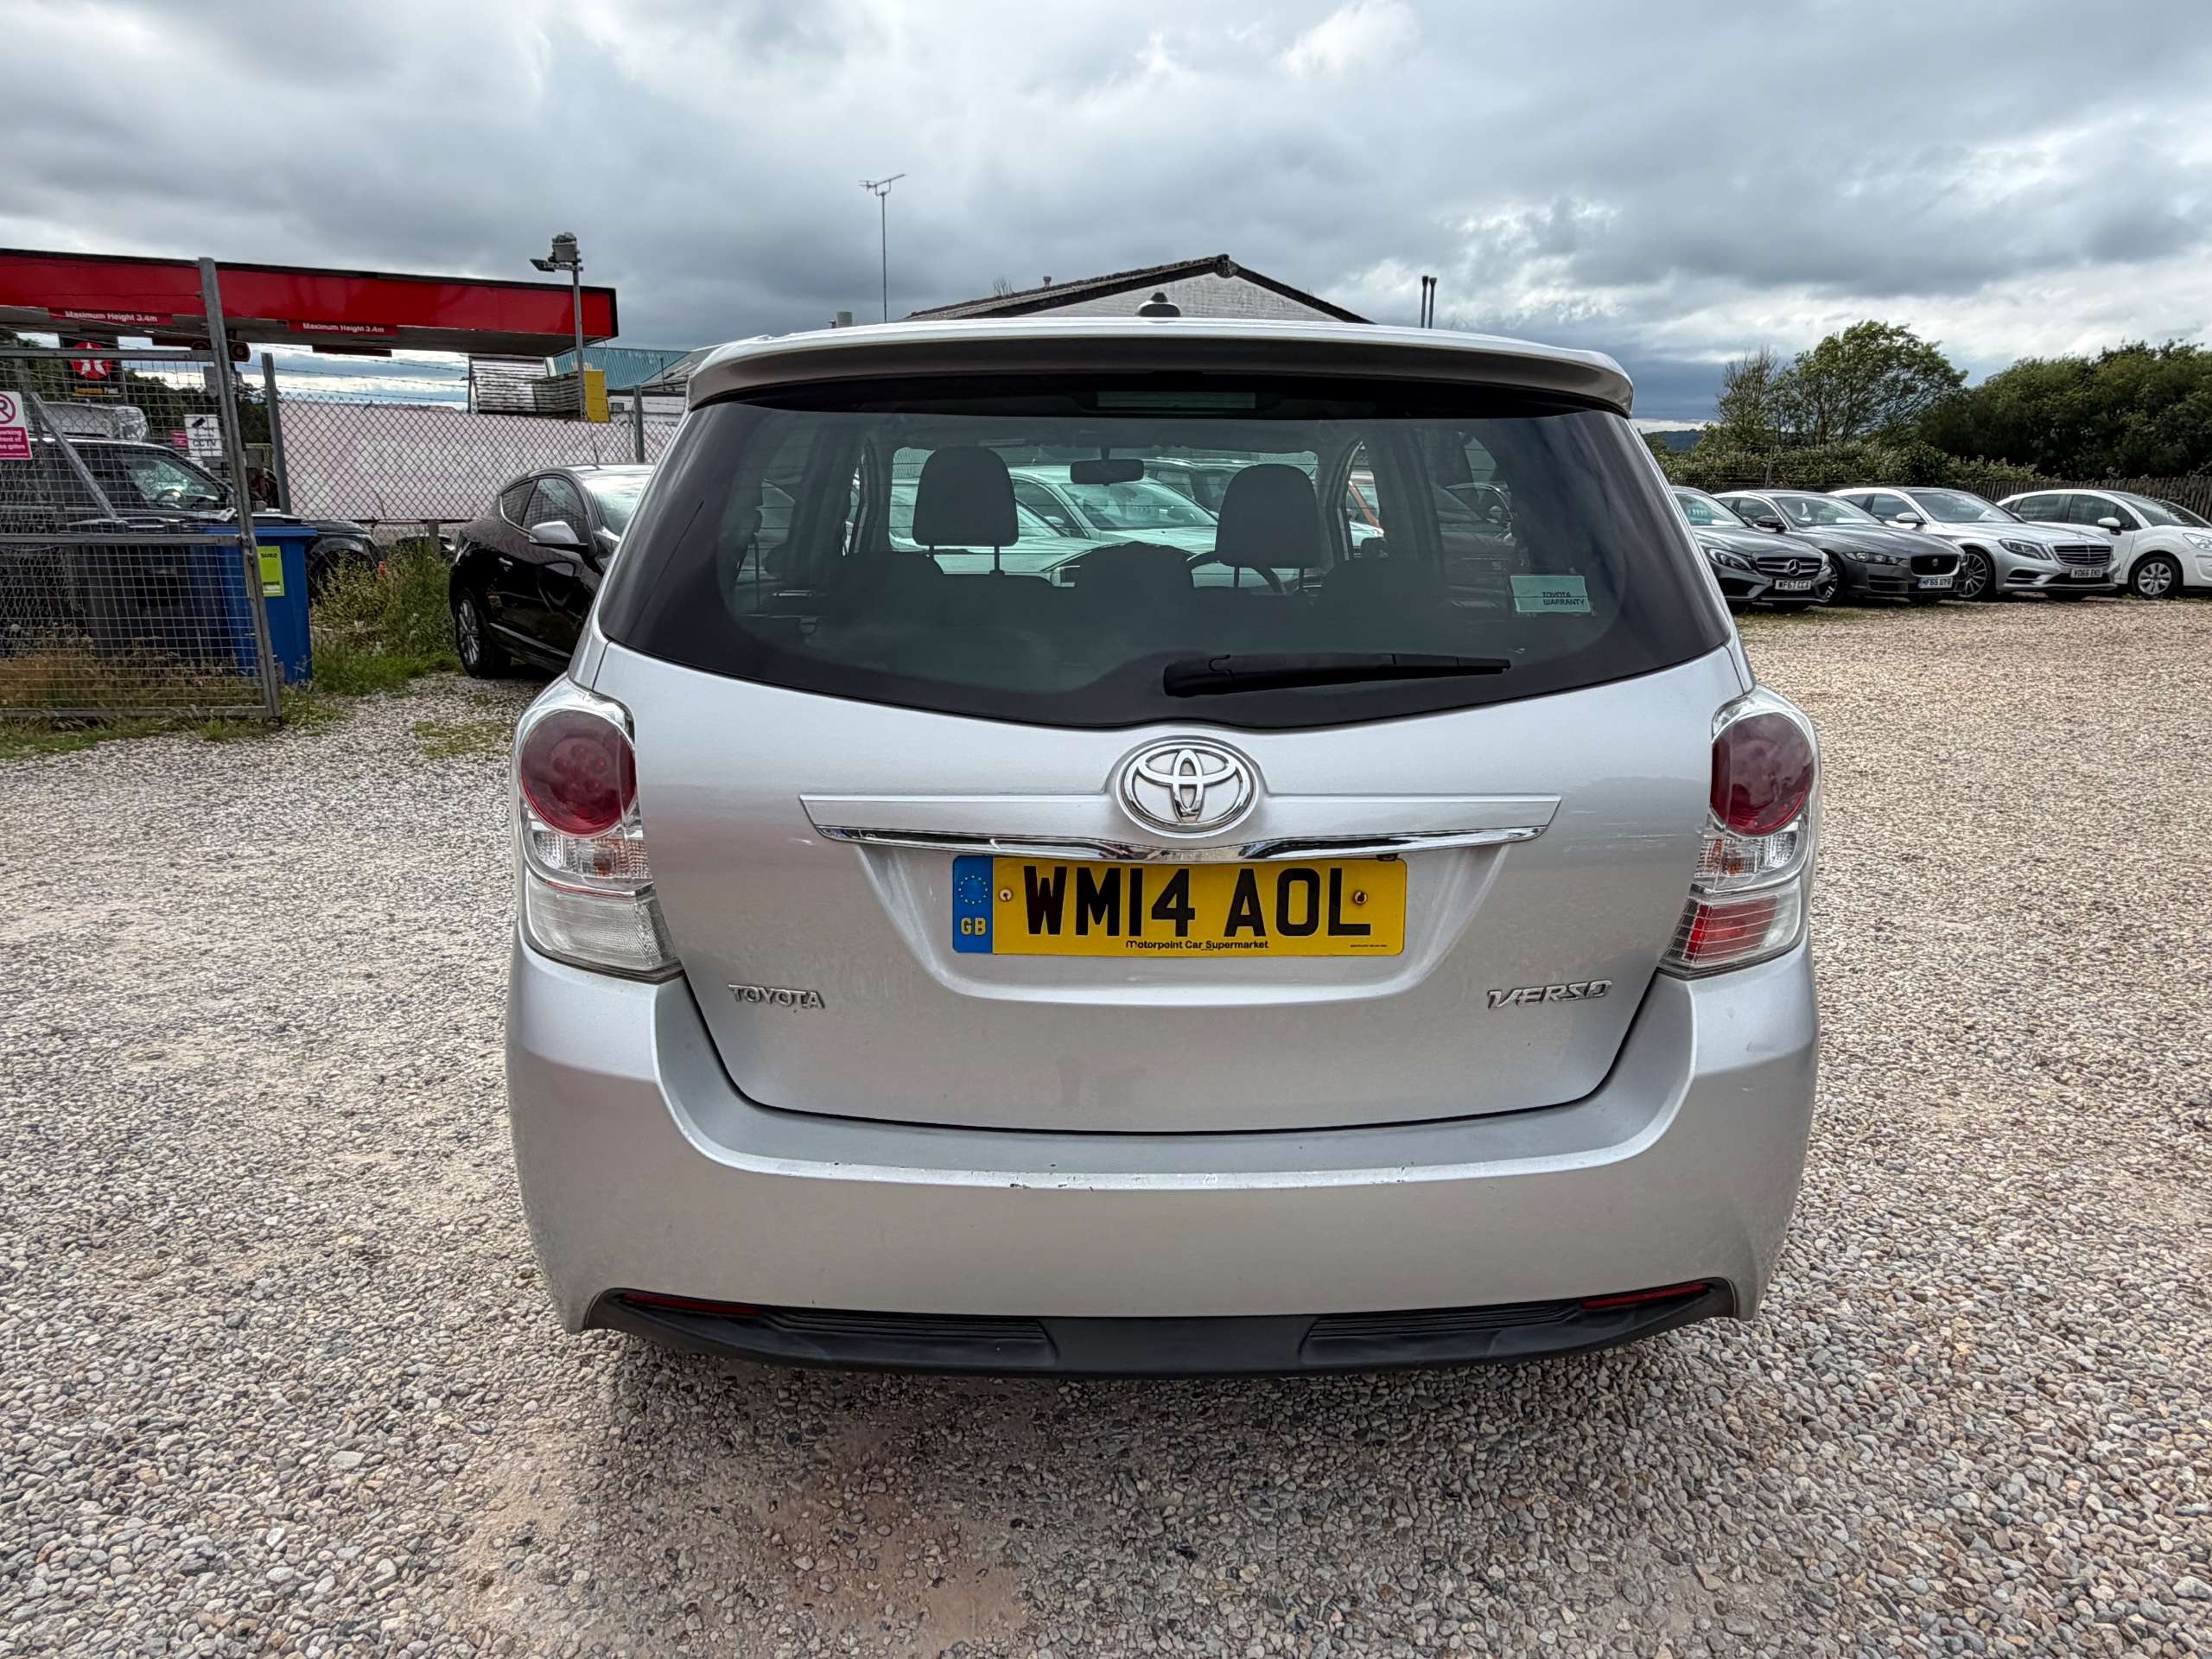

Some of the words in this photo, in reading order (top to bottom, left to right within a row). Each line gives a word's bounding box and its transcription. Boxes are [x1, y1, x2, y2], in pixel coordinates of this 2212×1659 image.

[65, 310, 105, 320] Maximum
[107, 312, 135, 322] Height
[302, 322, 339, 331] Maximum
[340, 324, 364, 334] Height
[193, 438, 216, 448] CCTV
[1023, 865, 1195, 938] WM14
[1224, 868, 1371, 938] AOL
[961, 917, 987, 936] GB
[1126, 940, 1183, 950] Motorpoint
[1185, 940, 1202, 949] Car
[1205, 940, 1268, 950] Supermarket
[728, 983, 826, 1009] TOYOTA
[1487, 979, 1613, 1009] VERSO
